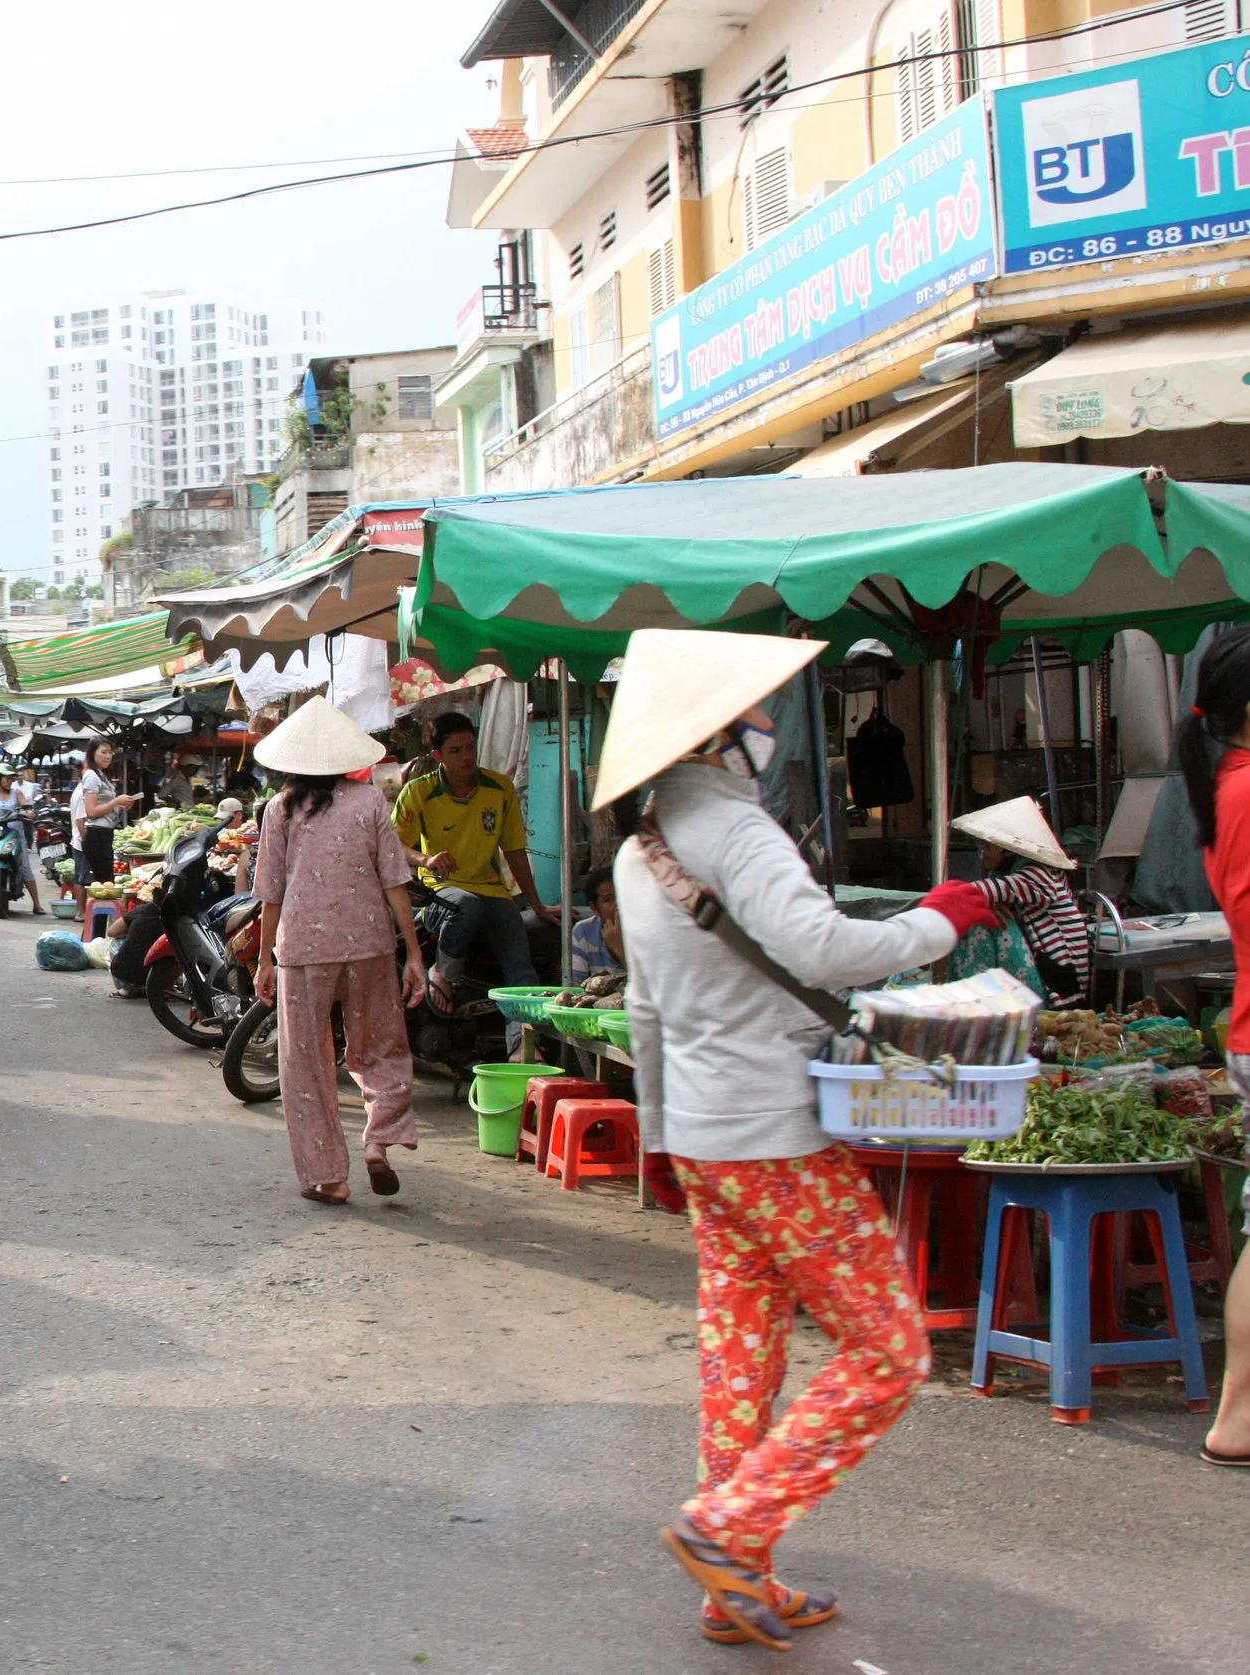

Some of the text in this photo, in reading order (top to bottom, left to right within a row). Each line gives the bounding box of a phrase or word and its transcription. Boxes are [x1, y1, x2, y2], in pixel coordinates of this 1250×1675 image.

[687, 159, 981, 391] TRUNG TÂM DỊCH VỤ CẦM ĐỒ
[717, 285, 729, 309] TY
[909, 127, 963, 184] THÀNH
[1028, 247, 1075, 267] ĐC:
[1082, 236, 1118, 258] 86
[1126, 239, 1138, 247] -
[1146, 226, 1183, 248] 88
[916, 258, 988, 305] ĐT: 38 205 407
